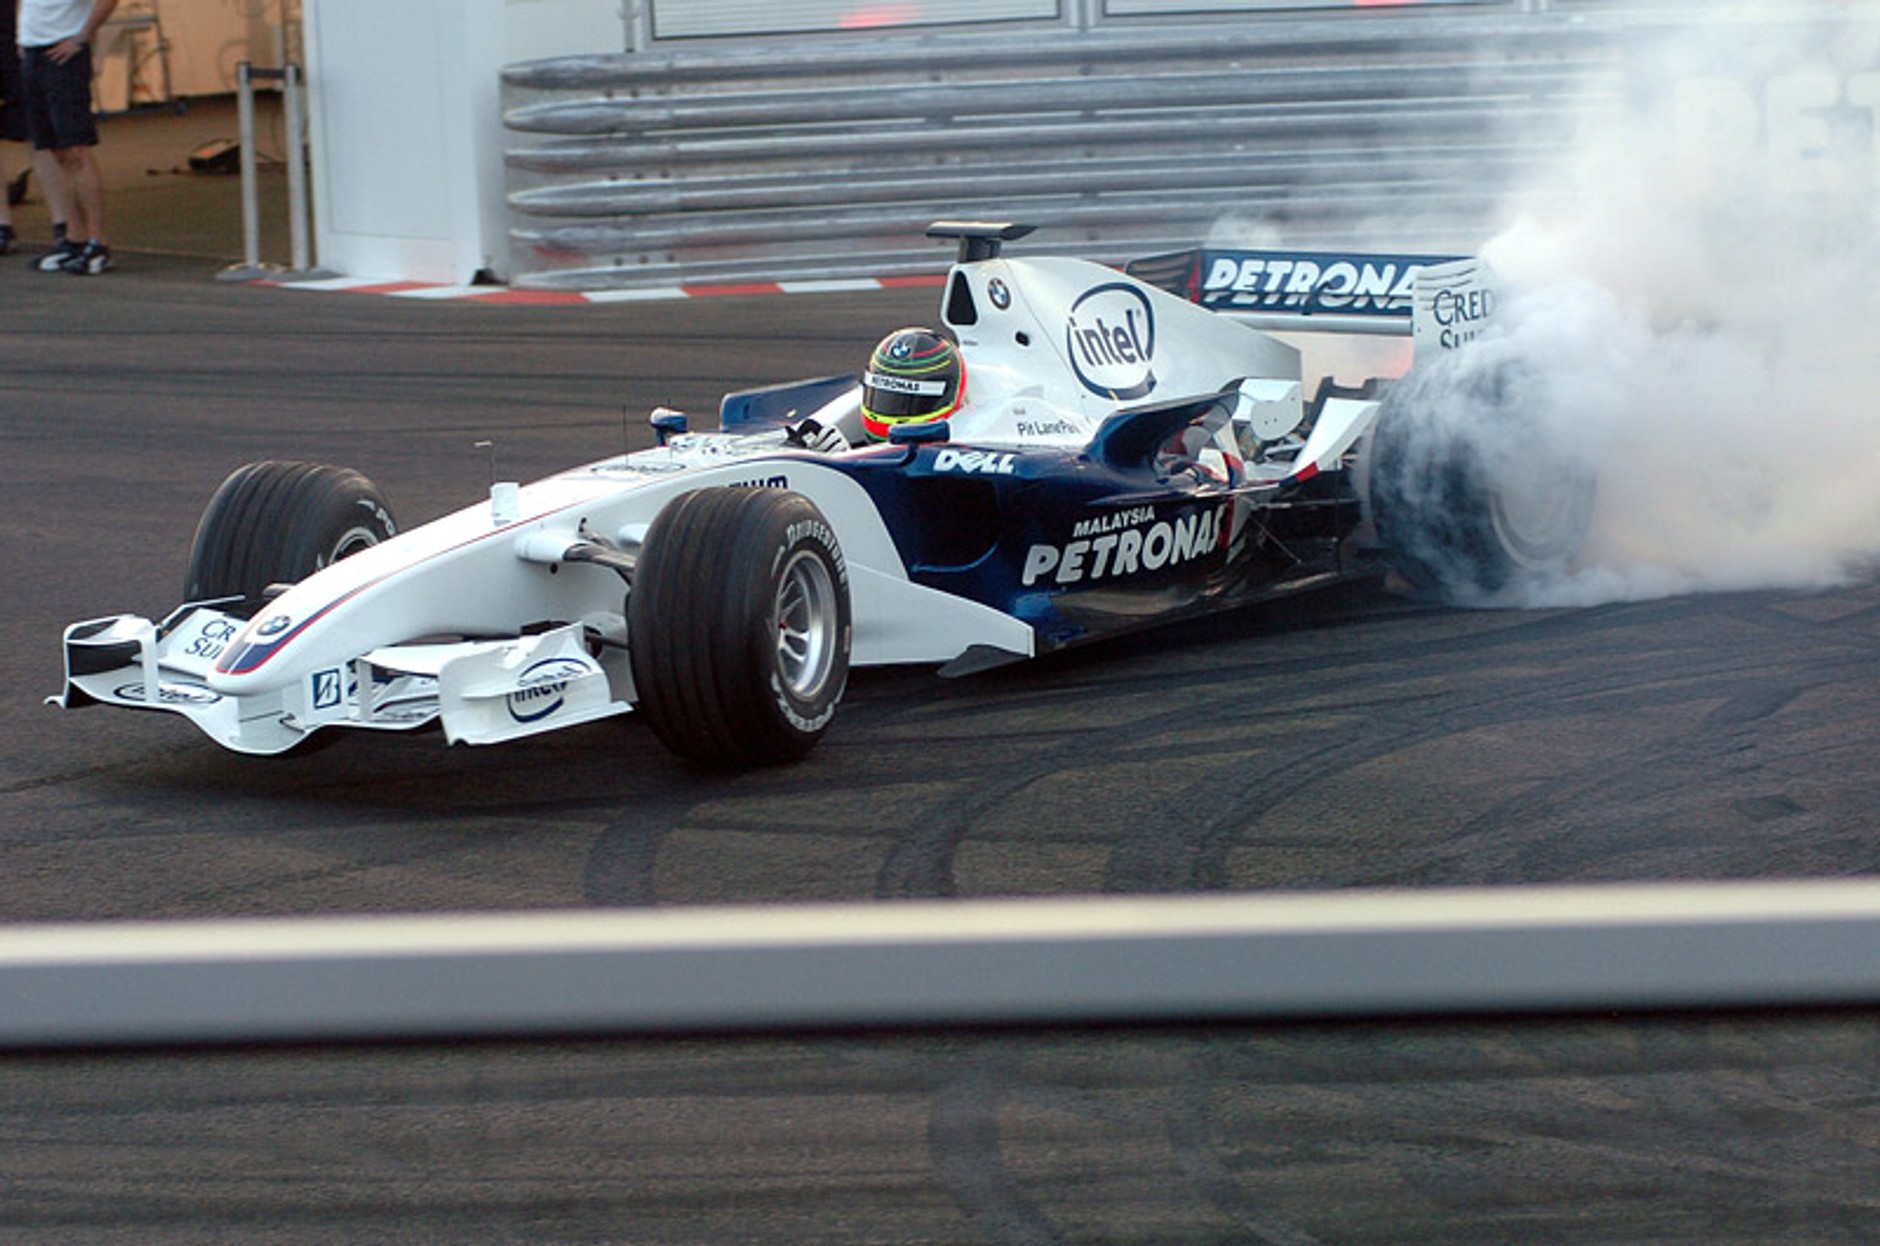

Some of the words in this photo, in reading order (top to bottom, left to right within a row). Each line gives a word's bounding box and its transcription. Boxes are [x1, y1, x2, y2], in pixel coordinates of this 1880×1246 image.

[1069, 308, 1147, 367] intel
[933, 449, 1016, 474] DELL
[1021, 503, 1228, 586] PETRONAS
[1073, 505, 1155, 538] MALAYSIA
